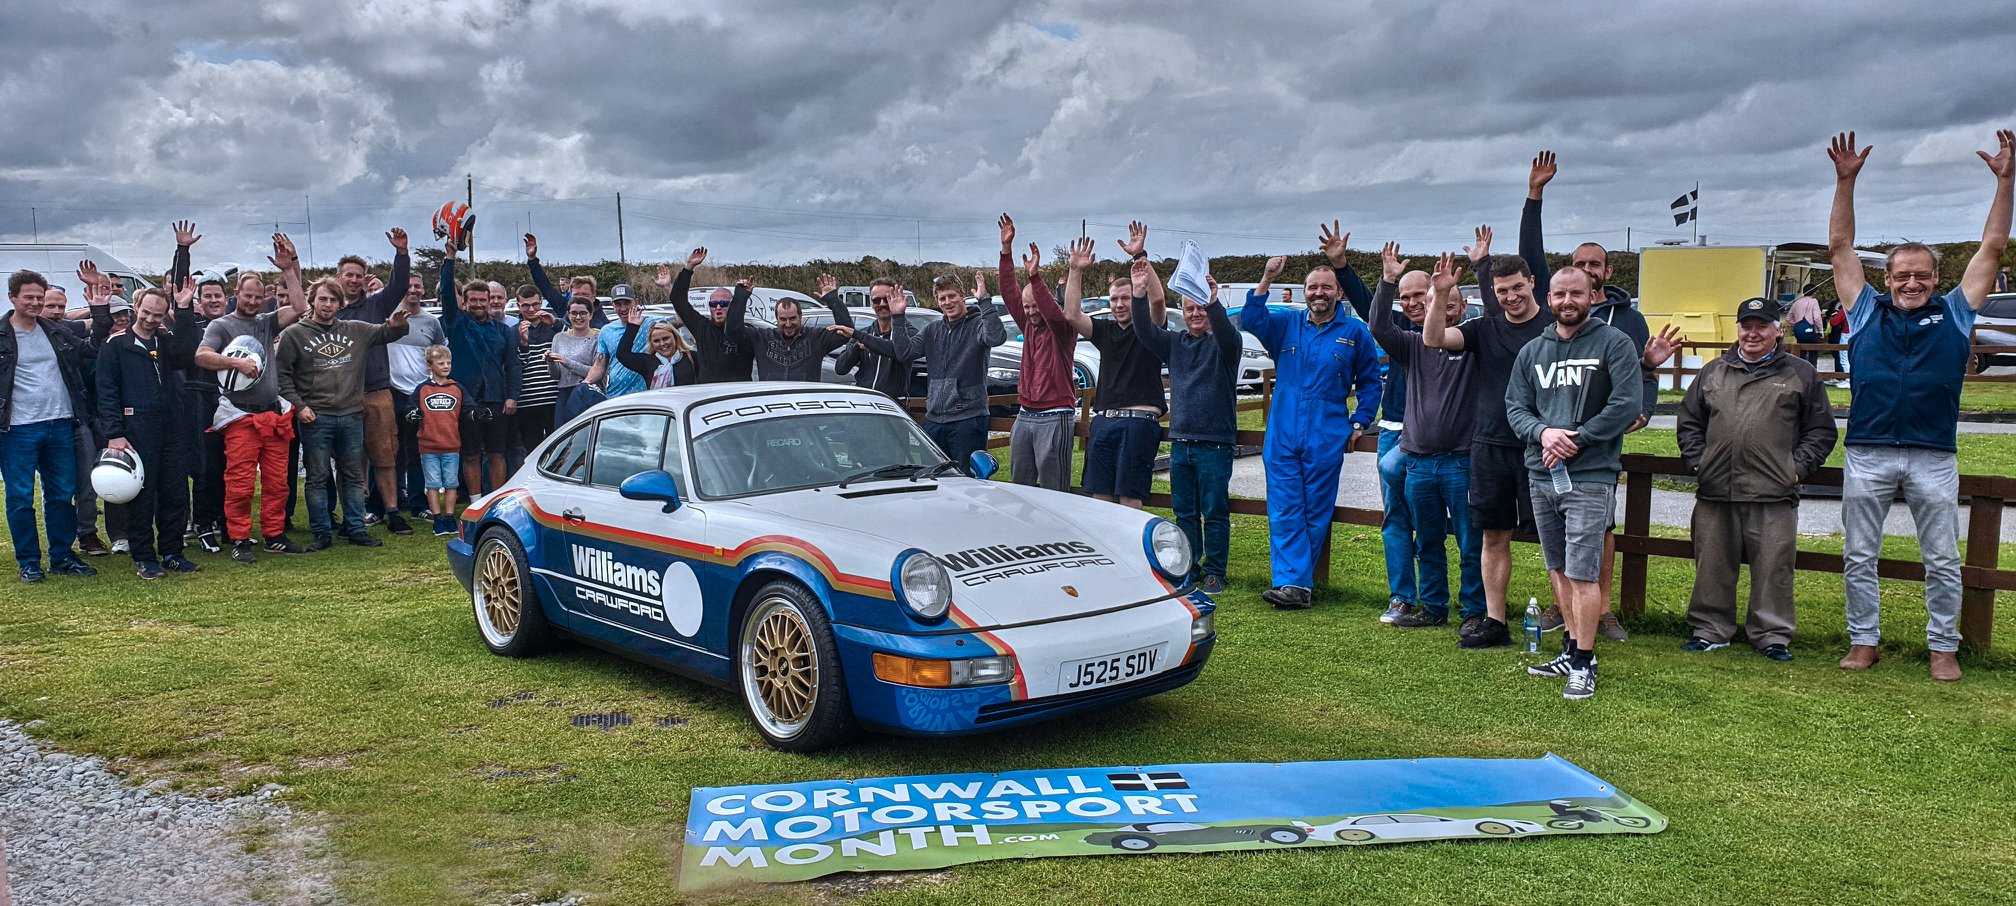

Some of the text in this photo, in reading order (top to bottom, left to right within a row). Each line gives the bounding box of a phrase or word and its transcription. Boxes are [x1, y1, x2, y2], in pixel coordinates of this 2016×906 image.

[1534, 358, 1600, 389] VAN
[701, 400, 900, 425] PORSCHE
[766, 438, 801, 447] RECARO
[571, 543, 661, 597] Williams
[937, 540, 1096, 572] Williams
[962, 557, 1116, 587] CRAWFORD
[575, 585, 664, 622] CRAWFORD
[1068, 648, 1158, 688] J525 SDV
[706, 775, 1103, 816] CORNWALL
[702, 794, 1199, 842] MOTORSPORT
[699, 823, 993, 869] MONTH
